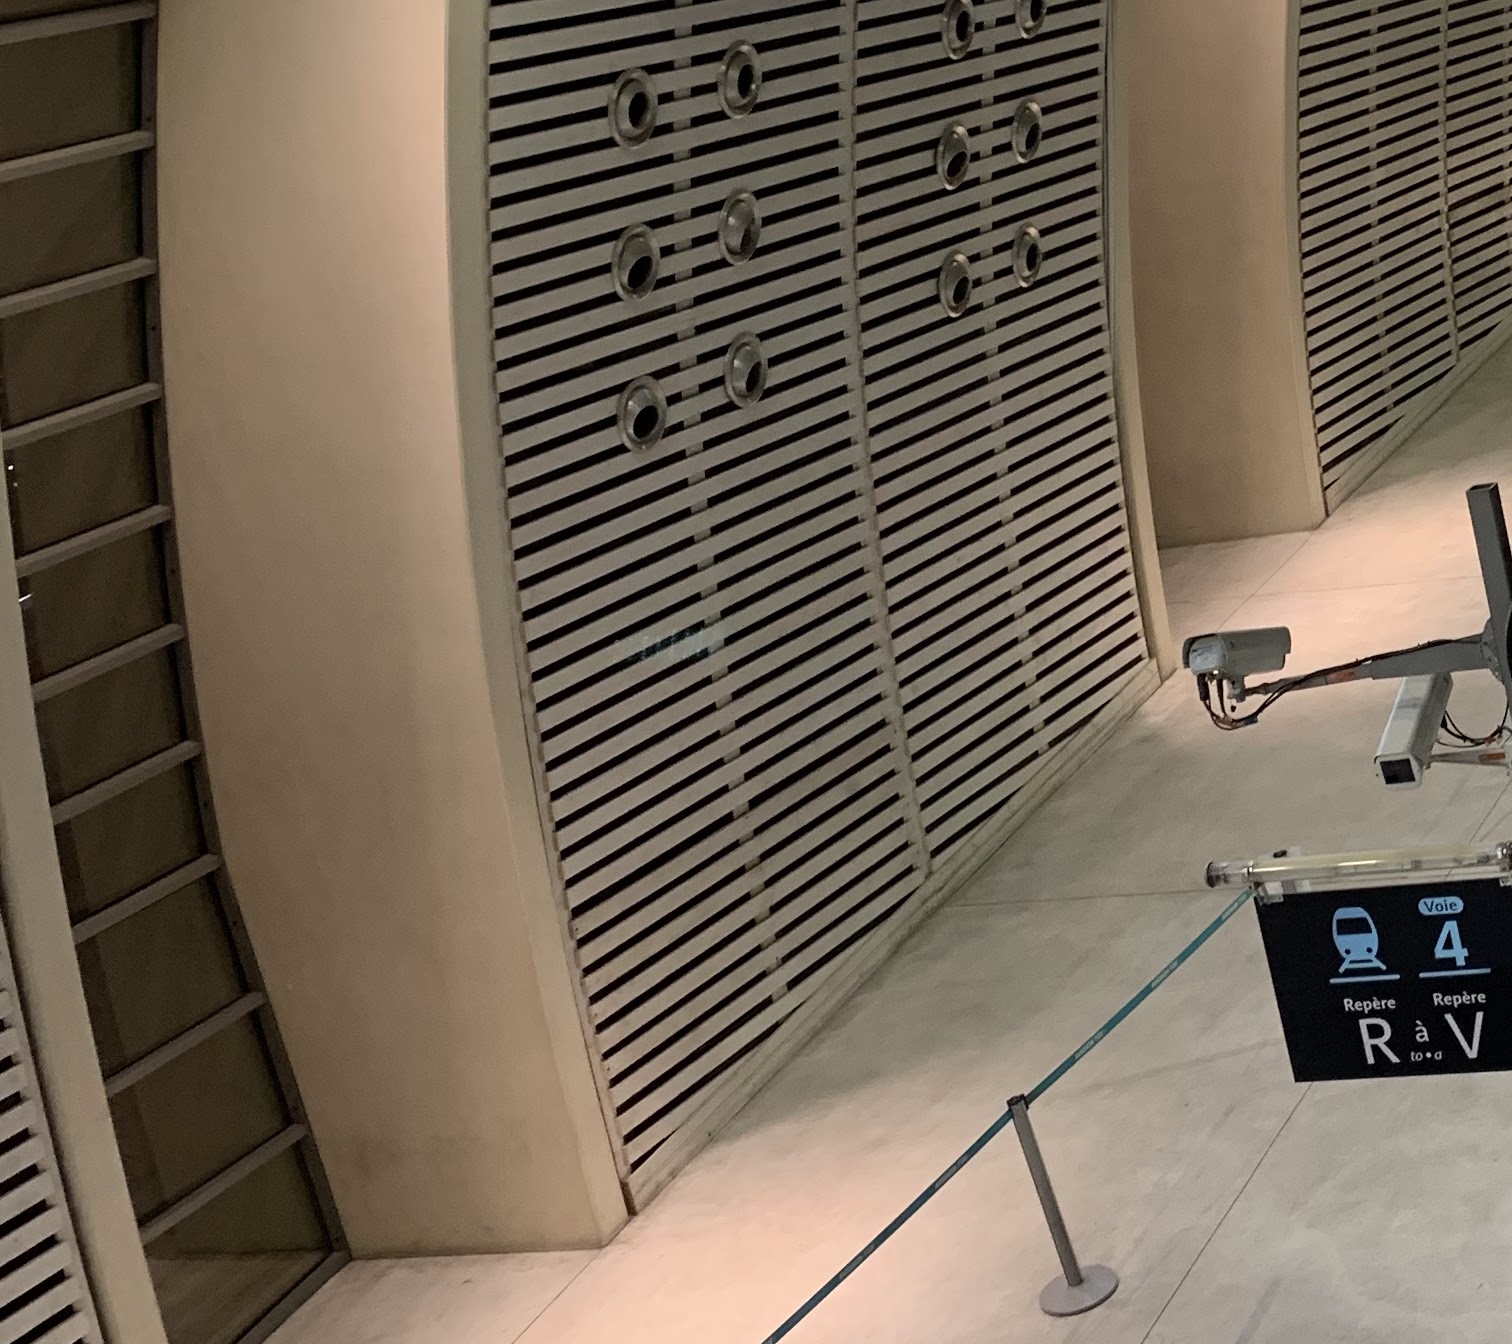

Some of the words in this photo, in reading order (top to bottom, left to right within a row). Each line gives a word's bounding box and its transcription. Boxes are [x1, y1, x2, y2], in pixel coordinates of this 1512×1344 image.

[1423, 899, 1457, 912] Voie
[1433, 920, 1469, 967] 4
[1343, 996, 1396, 1014] Repère
[1432, 992, 1487, 1008] Repère
[1358, 1017, 1400, 1065] R
[1415, 1020, 1430, 1043] à
[1444, 1011, 1484, 1060] V
